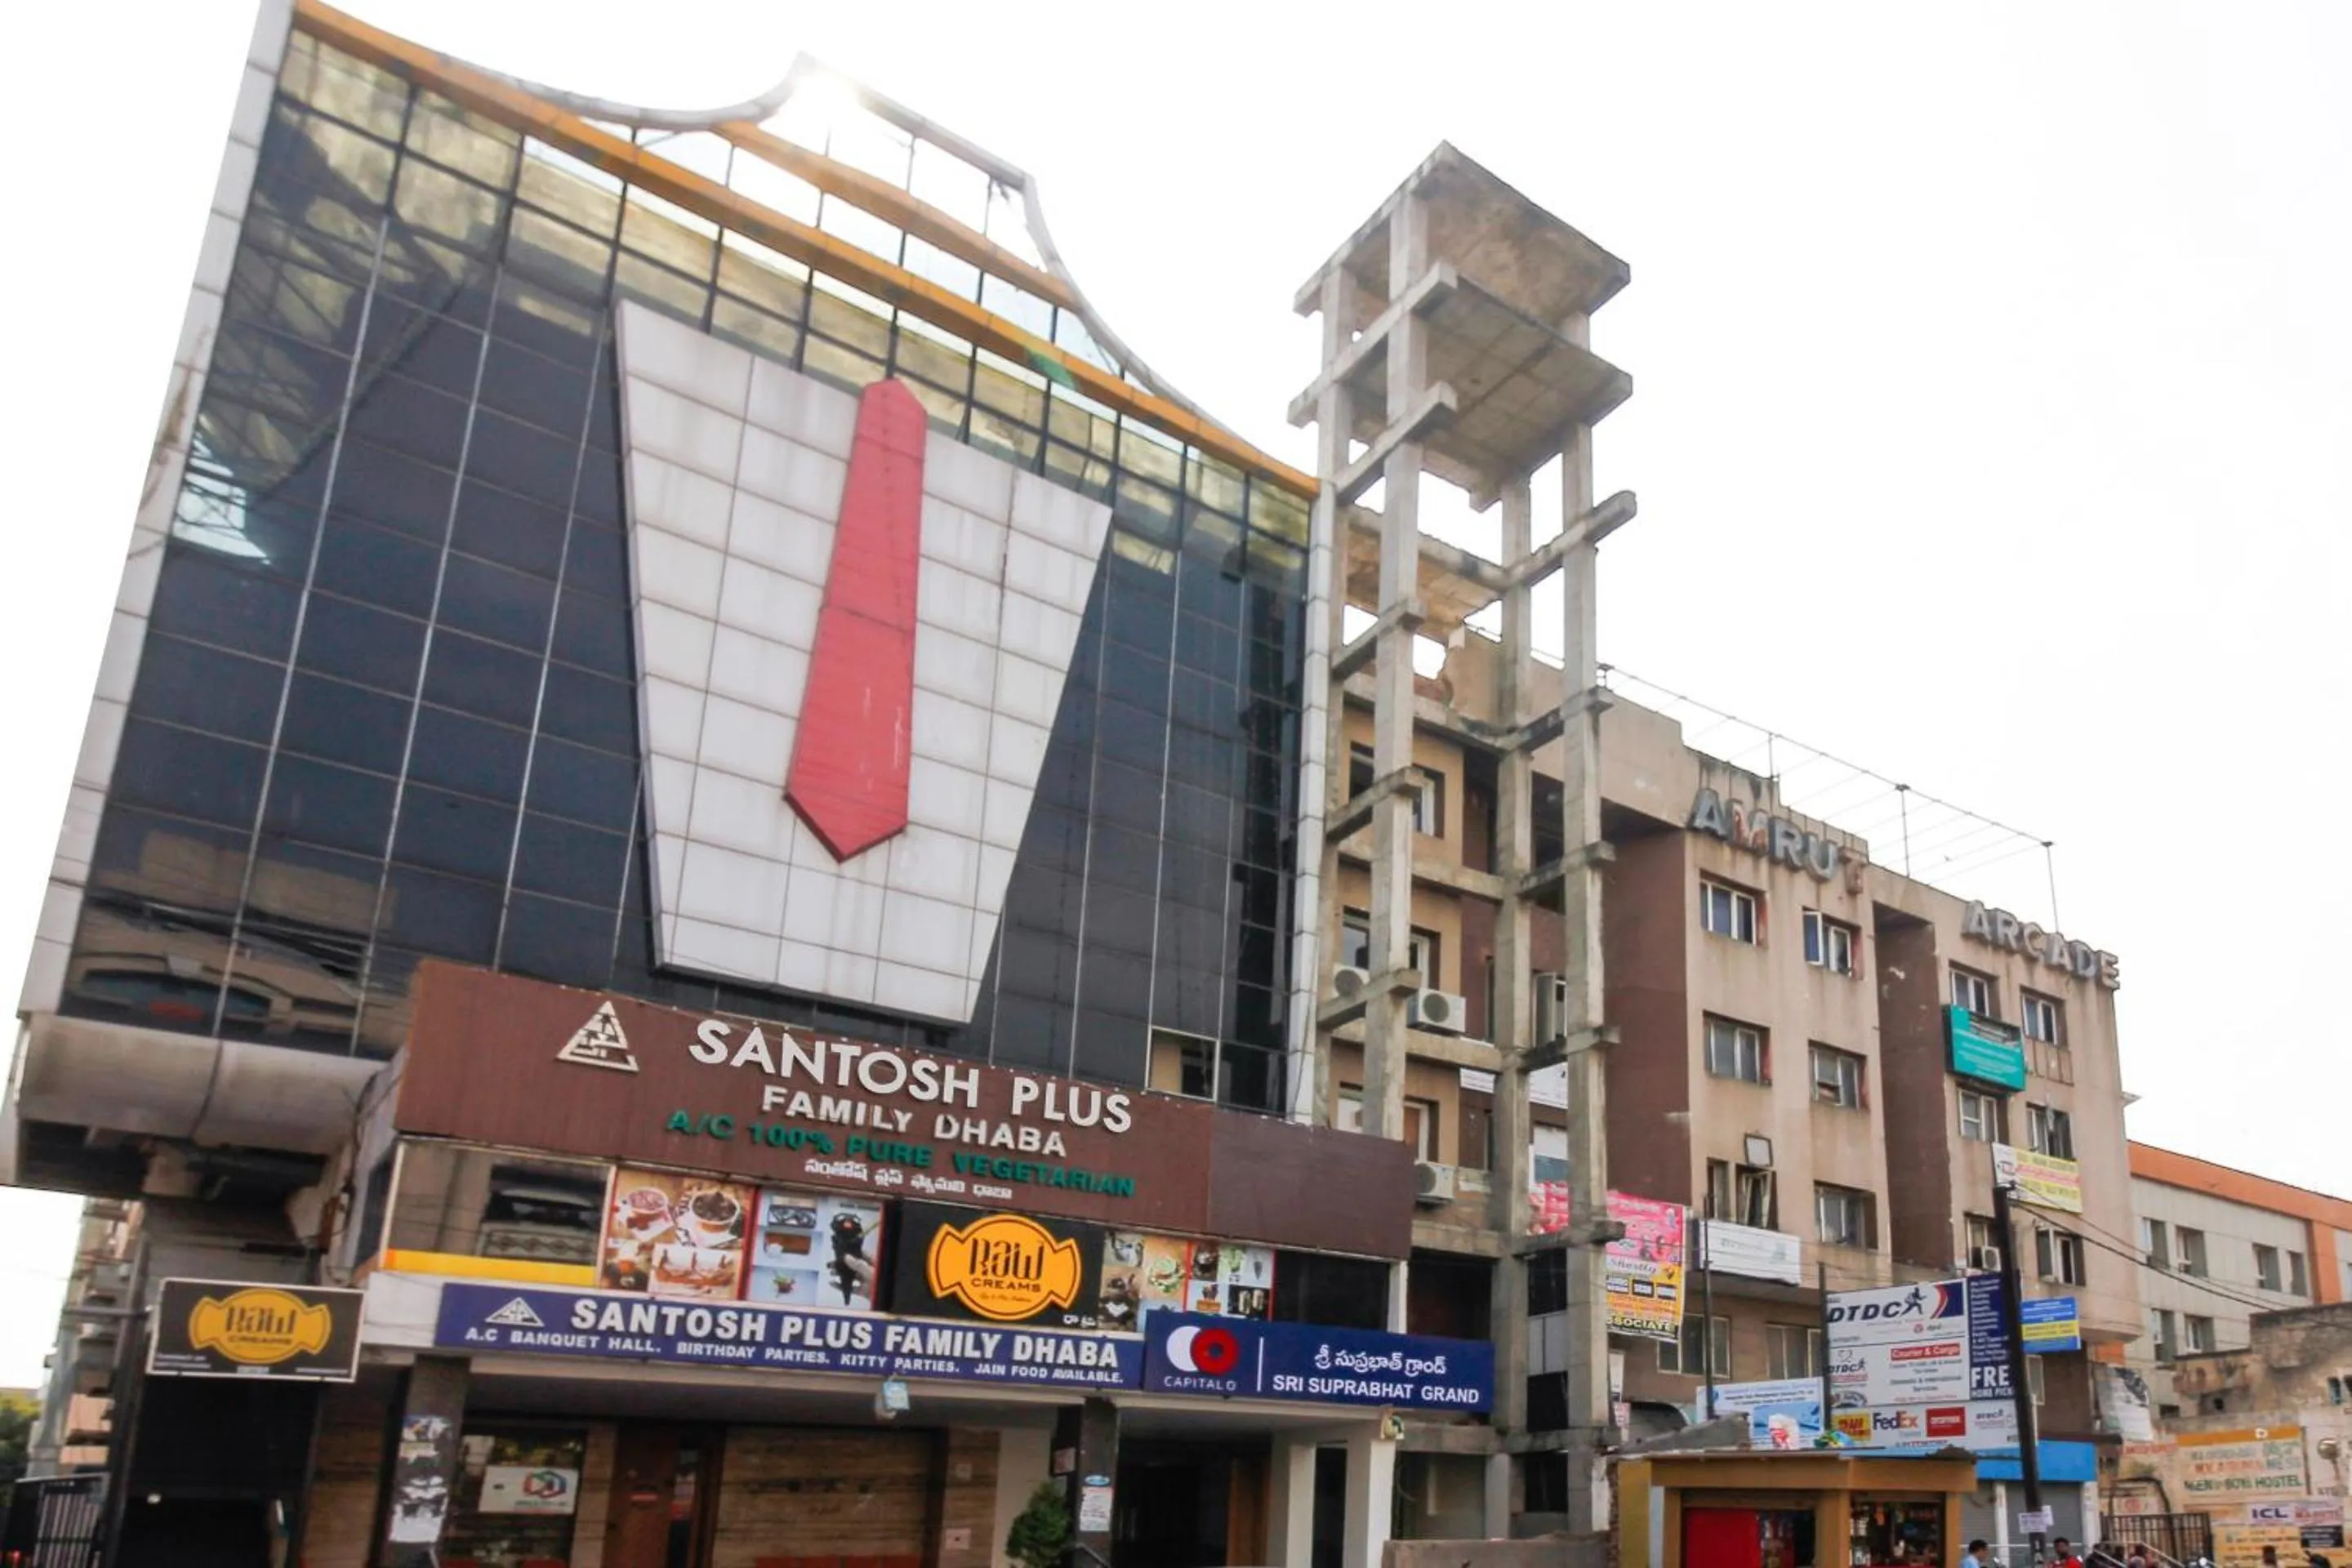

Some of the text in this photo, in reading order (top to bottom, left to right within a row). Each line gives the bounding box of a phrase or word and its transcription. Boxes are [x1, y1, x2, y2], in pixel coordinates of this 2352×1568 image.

[1687, 788, 1867, 894] AMRUT
[1962, 899, 2121, 990] ARCADE
[688, 1018, 1132, 1134] SANTOSH PLUS
[761, 1085, 1067, 1158] FAMILY DHABA
[667, 1110, 1134, 1197] A/C 100% PURE VEGETARIAN
[970, 1277, 1041, 1293] CREAMS
[1828, 1301, 1902, 1324] DTDC
[571, 1298, 1119, 1370] SANTOSH PLUS FAMILY DHABA
[465, 1326, 498, 1343] A.C
[510, 1330, 600, 1350] BANQUET
[608, 1335, 662, 1354] HALL.
[676, 1340, 755, 1361] BIRTHDAY
[764, 1346, 830, 1365] PARTIES.
[840, 1352, 889, 1370] KITTY
[894, 1356, 960, 1374] PARTIES.
[973, 1362, 1007, 1377] JAIN
[1011, 1365, 1049, 1380] FOOD
[1334, 1349, 1404, 1373] సుప్రభాత్
[1404, 1356, 1447, 1378] గ్రాండ్
[1164, 1376, 1223, 1390] CAPITAL
[1273, 1374, 1480, 1404] SRI SUPRABHAT GRAND
[1971, 1365, 2010, 1388] FRE
[1873, 1410, 1918, 1431] FedEx
[2252, 1508, 2287, 1519] ICL
